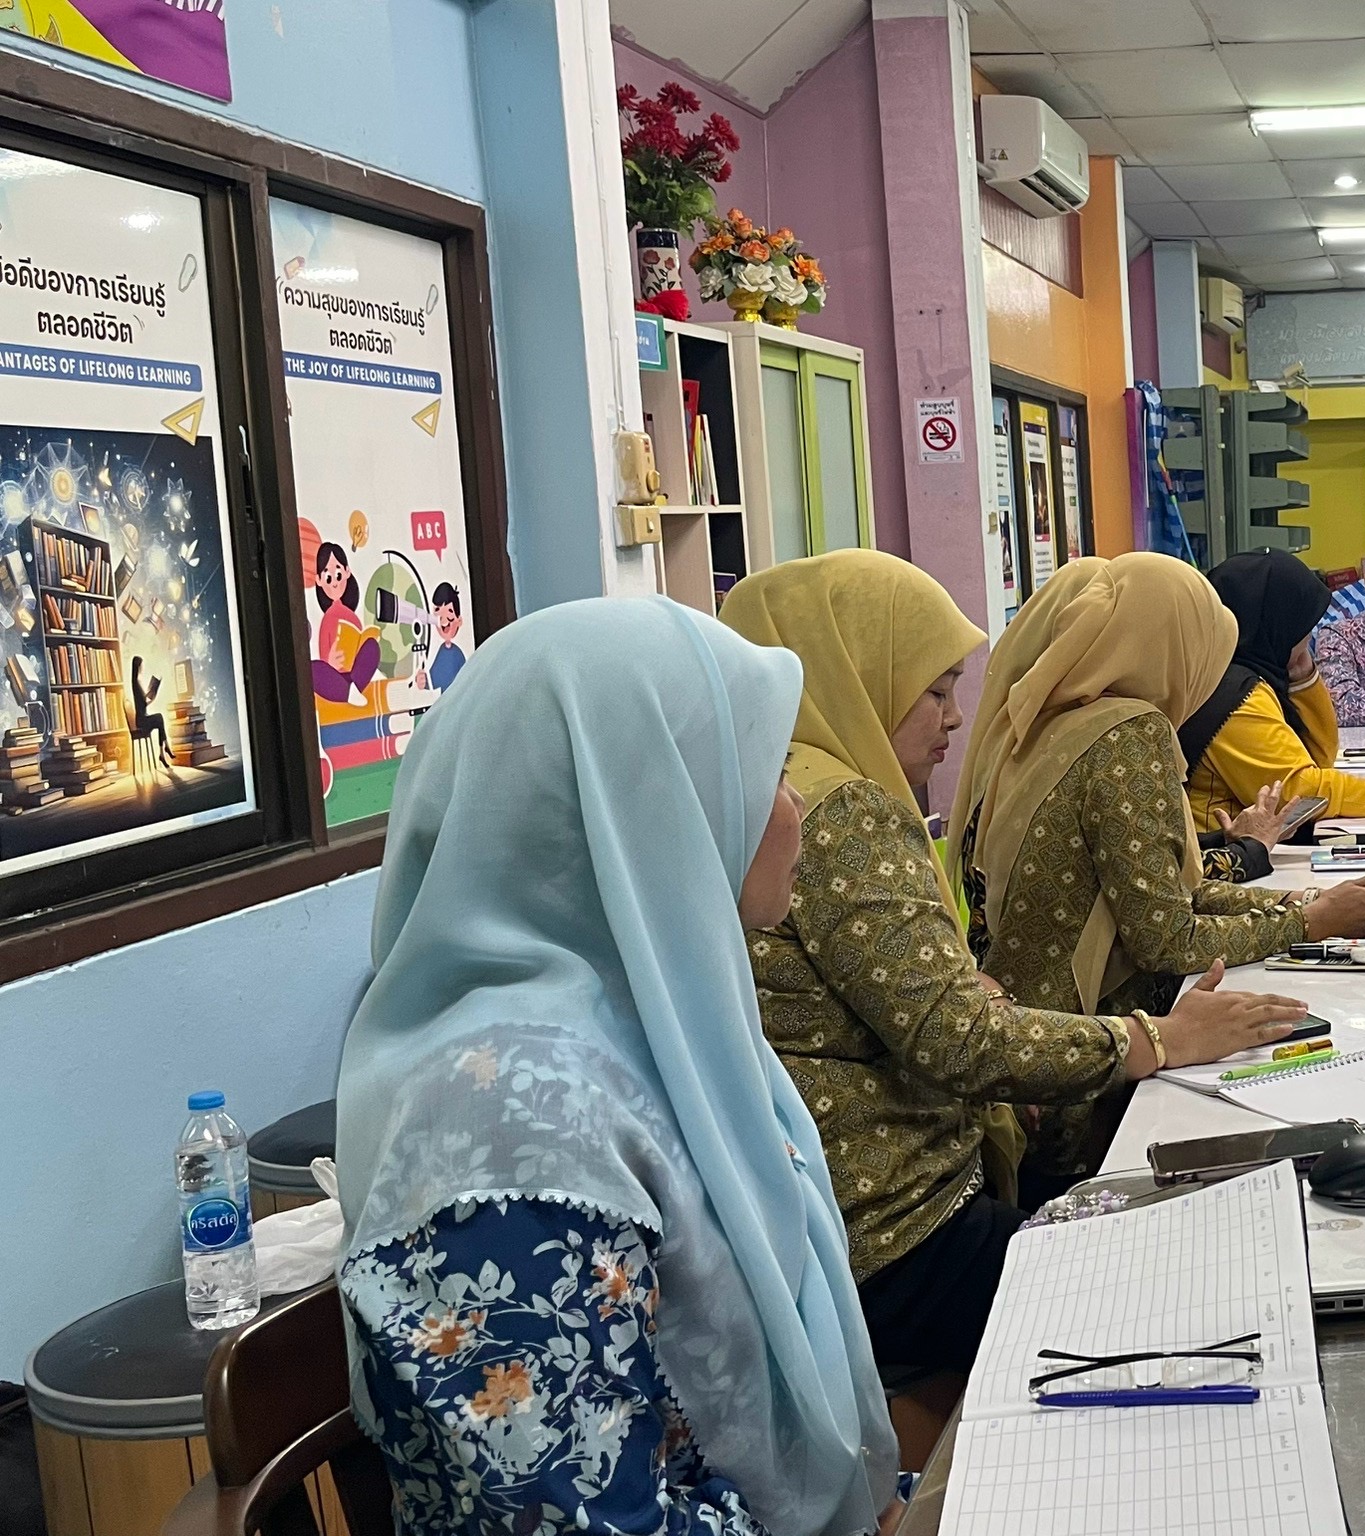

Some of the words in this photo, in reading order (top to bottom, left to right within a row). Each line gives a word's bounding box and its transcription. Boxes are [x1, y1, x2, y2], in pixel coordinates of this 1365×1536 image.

[0, 255, 166, 318] อดีของการเรียนรู้
[37, 310, 134, 344] ตลอดชีวิต
[283, 285, 426, 336] ความสุขของการเรียนรู้
[329, 327, 393, 355] ตลอดชีวิต
[59, 357, 76, 375] OF
[79, 359, 135, 380] LIFELONG
[136, 366, 192, 386] LEARNING
[285, 357, 306, 374] THE
[308, 360, 329, 377] JOY
[331, 363, 344, 378] OF
[346, 365, 391, 384] LIFELONG
[392, 371, 436, 390] LEARNING
[417, 521, 442, 540] ABC
